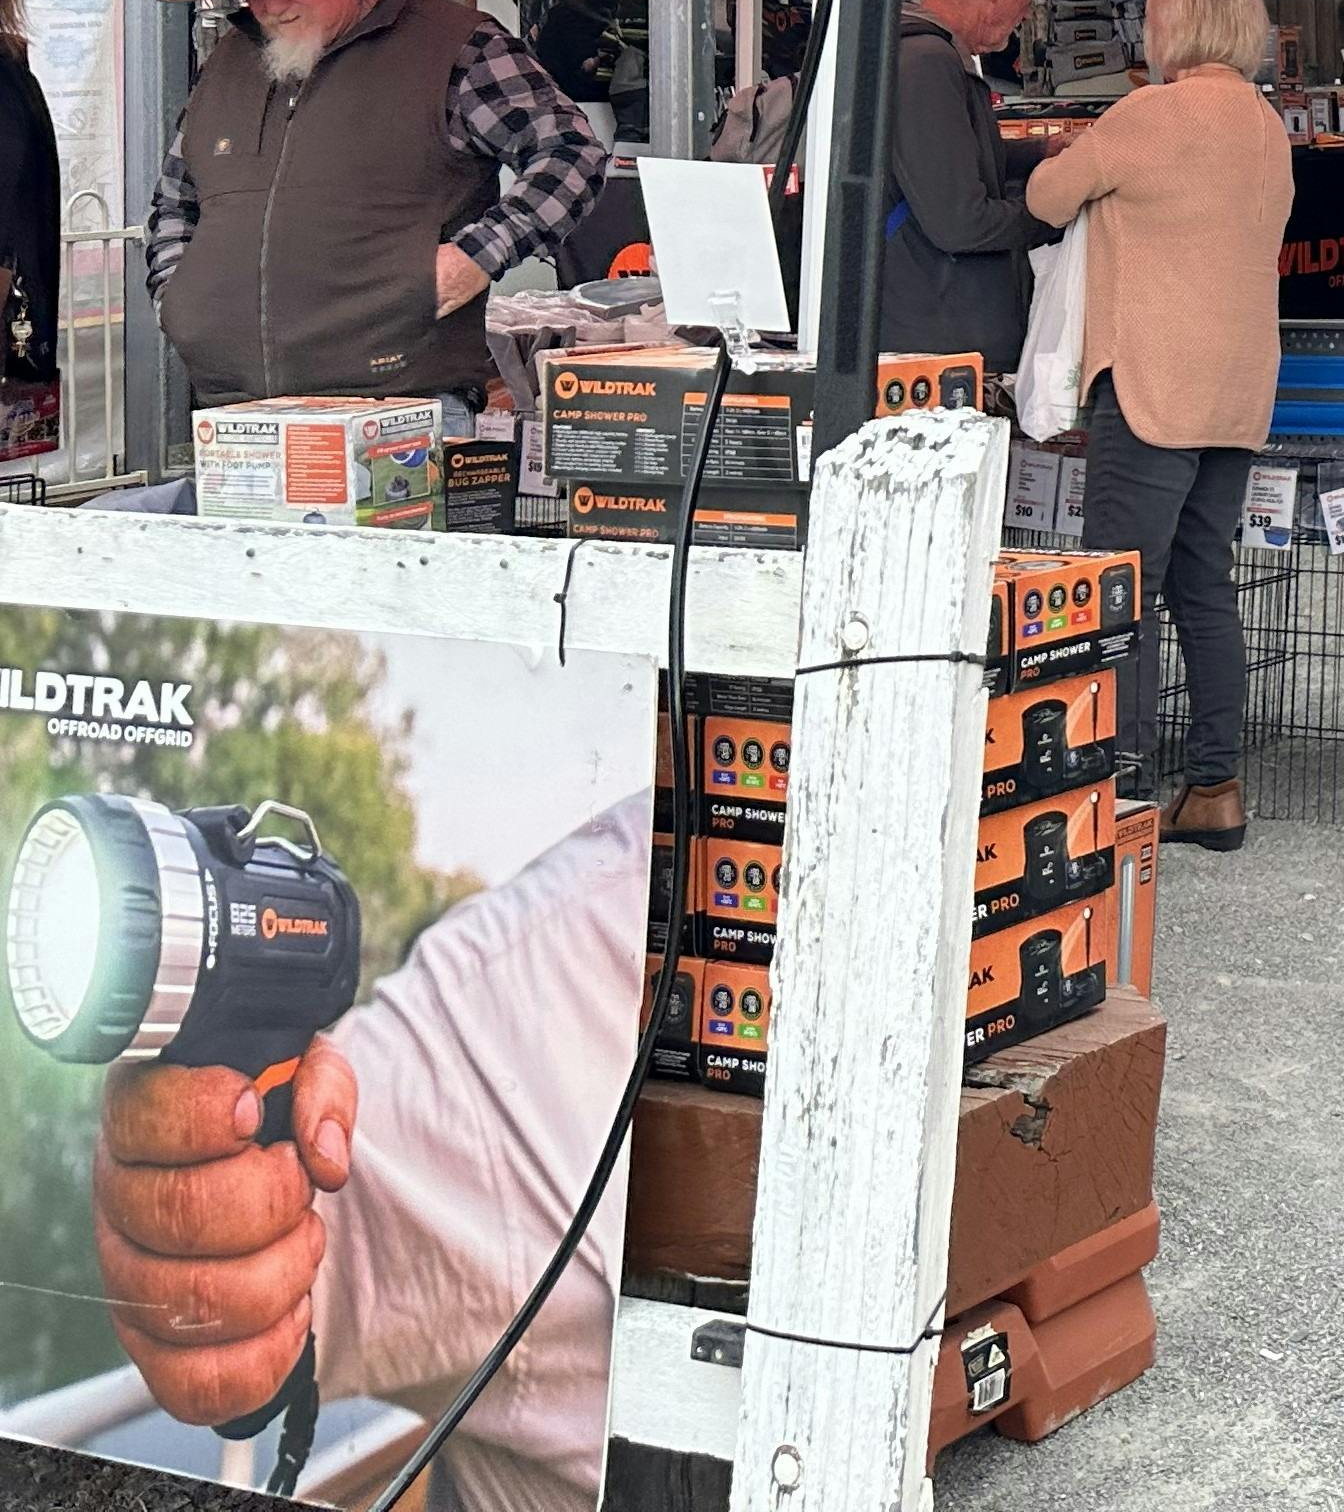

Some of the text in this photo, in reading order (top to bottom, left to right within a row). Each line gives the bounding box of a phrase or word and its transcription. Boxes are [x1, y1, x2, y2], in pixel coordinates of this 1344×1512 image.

[578, 380, 657, 397] WILDTRAK
[381, 410, 433, 428] WILDTRAK
[552, 409, 648, 423] CAMP SHOWER PRO
[216, 422, 278, 435] WILDTRAK
[243, 449, 281, 460] SHOWER
[465, 453, 509, 465] WILDTRAK
[447, 472, 511, 488] BUG ZAPPER
[593, 494, 667, 513] WILDTRAK
[1015, 504, 1033, 518] $10
[1068, 505, 1084, 518] $2
[1249, 514, 1272, 528] $39
[572, 524, 660, 539] CAMP SHOWER PRO
[1020, 641, 1092, 669] CAMP SHOWER
[1020, 668, 1040, 680] PRO
[0, 667, 194, 726] ILDTRAK
[47, 717, 193, 748] OFFROAD OFFGRID
[986, 778, 1016, 799] PRO
[711, 803, 786, 824] CAMP SHOWE
[712, 817, 735, 830] PRO
[990, 892, 1020, 914] PRO
[206, 883, 219, 948] FOCUS
[277, 917, 328, 936] WILDTRAK
[713, 926, 779, 945] CAMP SHOW
[713, 939, 737, 953] PRO
[987, 1014, 1016, 1038] PRO
[707, 1054, 765, 1073] CAMP SHO
[706, 1067, 731, 1081] PRO
